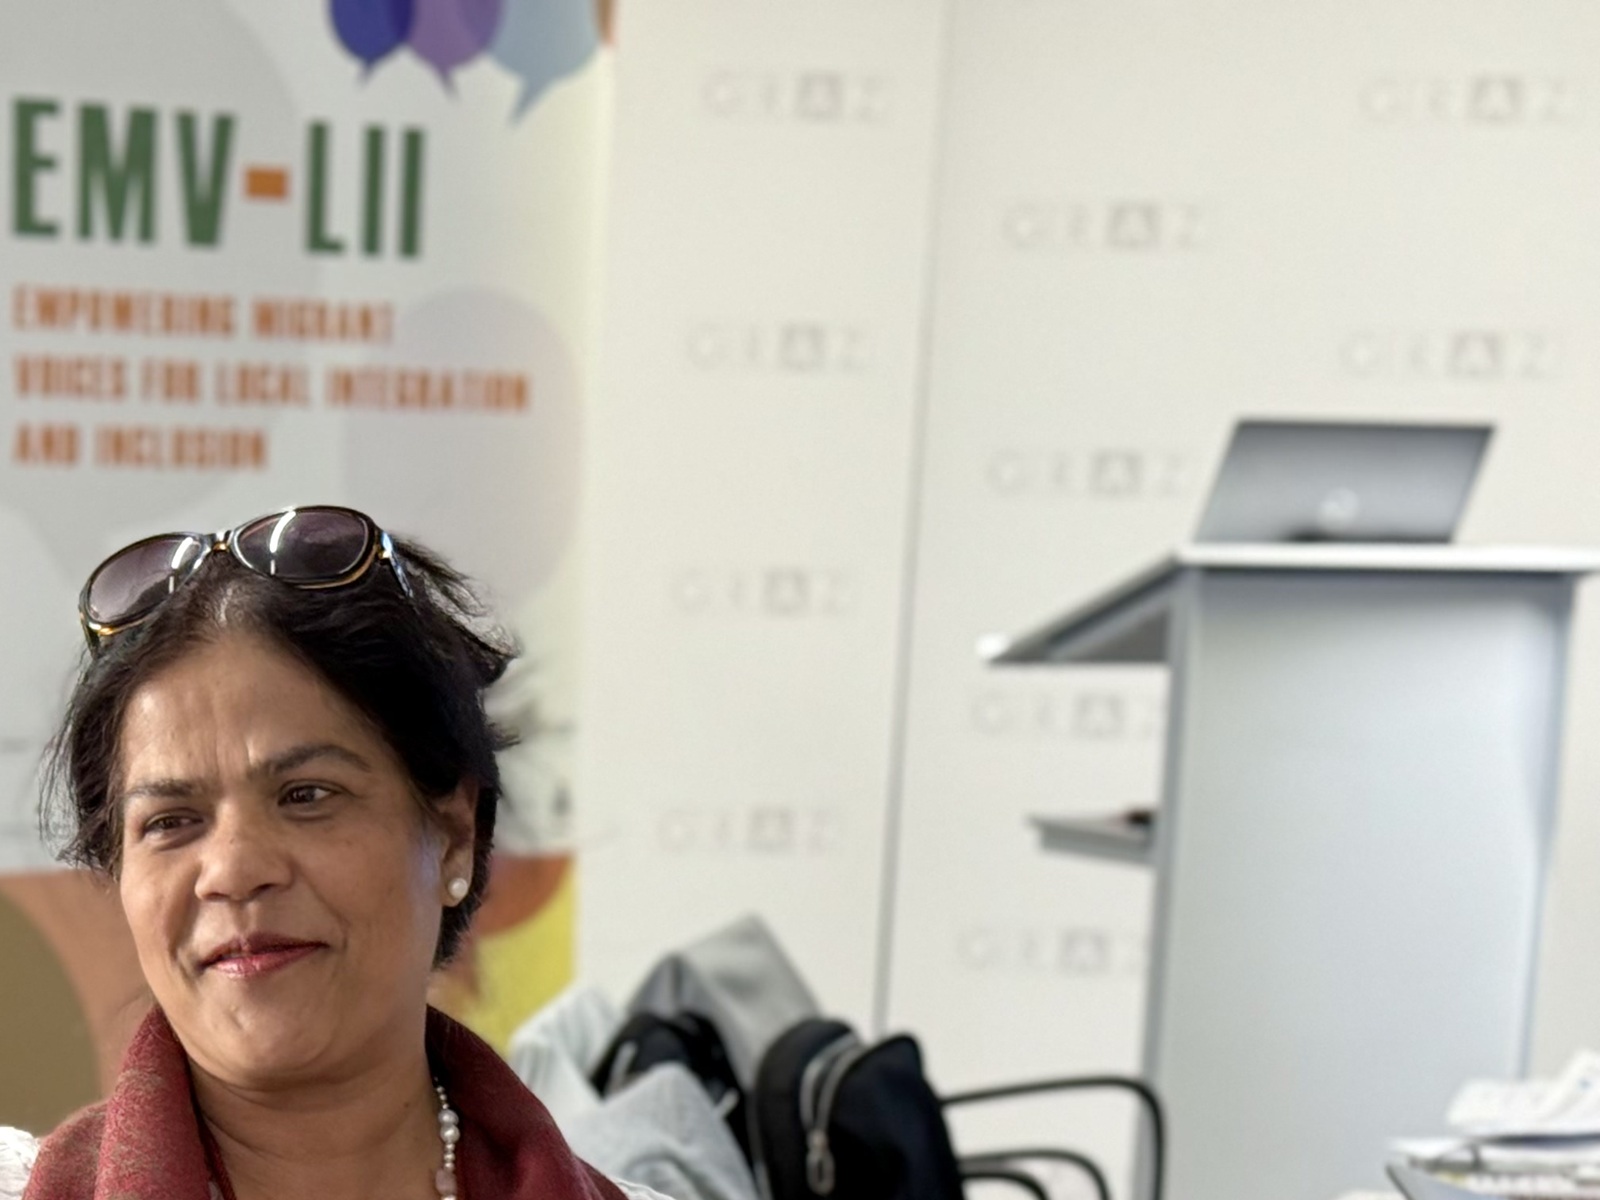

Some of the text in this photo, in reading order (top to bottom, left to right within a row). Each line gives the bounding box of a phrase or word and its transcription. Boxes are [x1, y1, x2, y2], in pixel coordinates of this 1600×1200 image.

[702, 69, 889, 124] GRAZ
[1359, 72, 1573, 127] GRAZ
[12, 98, 427, 258] EMV-LII
[1003, 198, 1206, 254] GRAZ
[13, 287, 392, 343] EMPOWERING MIGRANT
[685, 320, 869, 376] GRAZ
[1340, 328, 1553, 383] GRAZ
[14, 355, 530, 411] VOICES FOR LOCAL INTEGRATION
[13, 423, 268, 470] AND INCLUSION
[986, 446, 1183, 501] GRAZ
[670, 565, 849, 619] GRAZ
[655, 803, 838, 858] GRAZ
